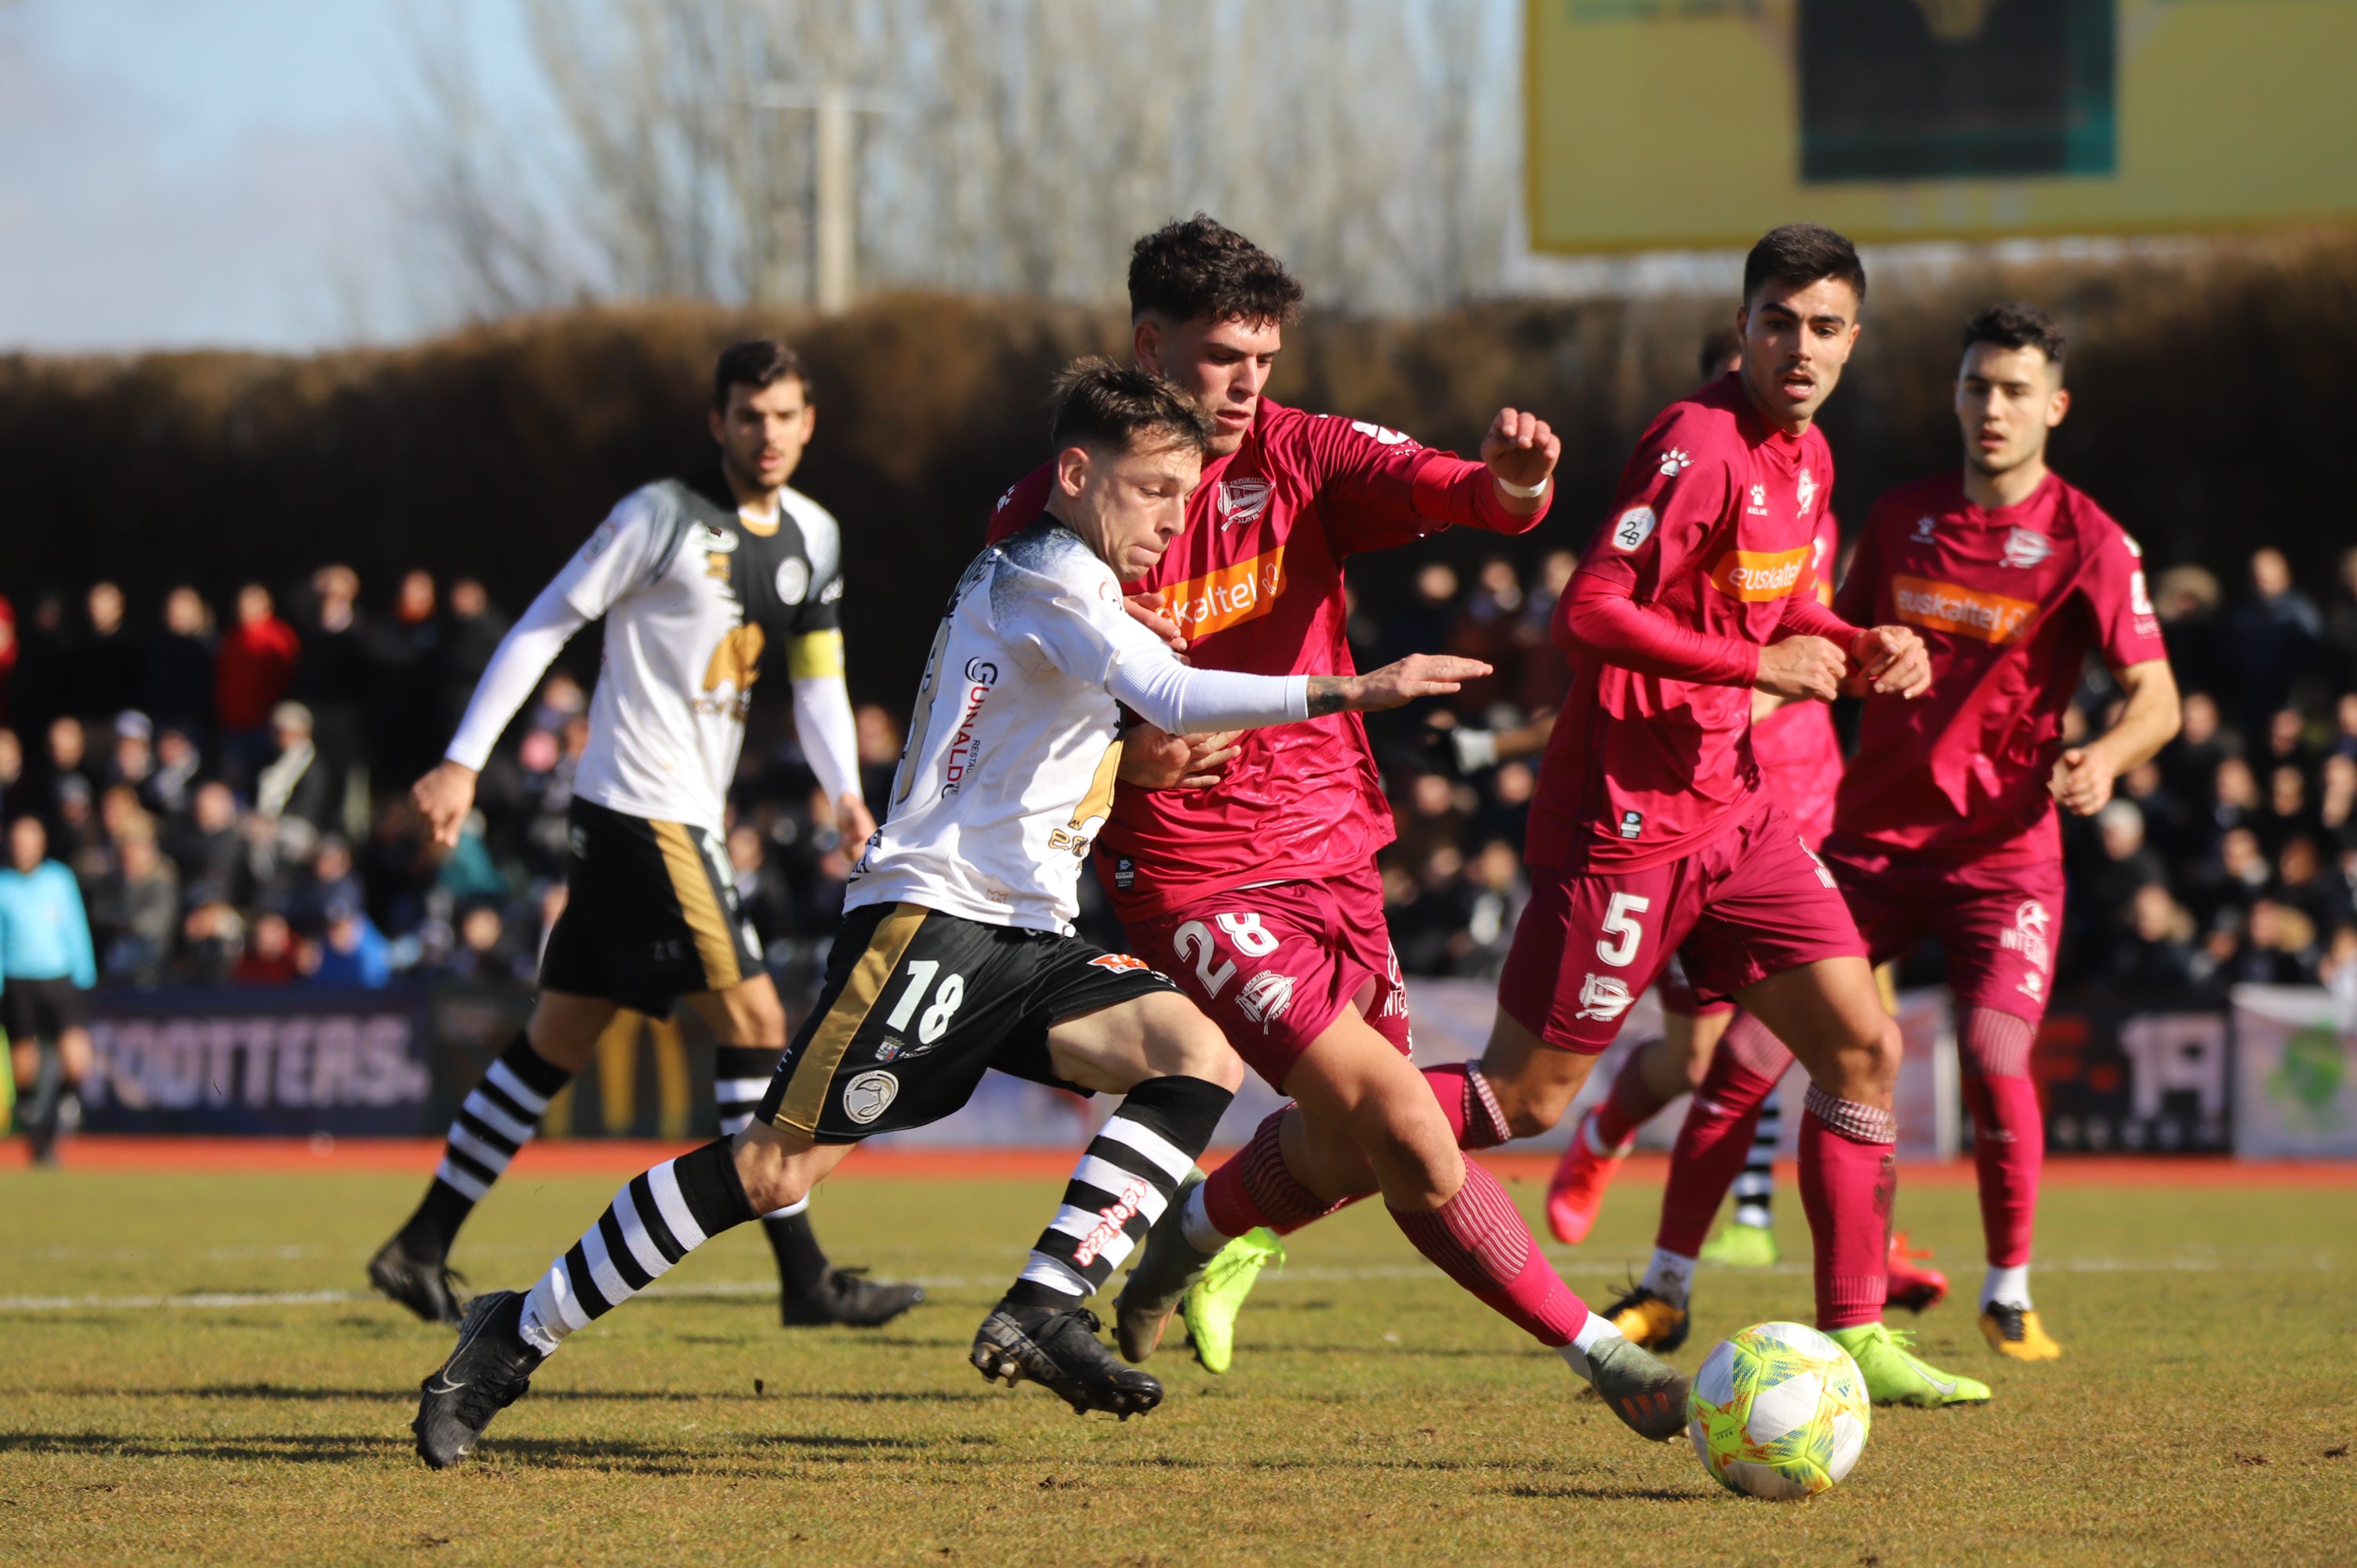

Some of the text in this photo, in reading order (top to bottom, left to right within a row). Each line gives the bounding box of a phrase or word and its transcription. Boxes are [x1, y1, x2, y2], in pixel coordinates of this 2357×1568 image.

[1728, 557, 1803, 590] euskaltel
[1898, 590, 2004, 631] euskaltel
[1173, 912, 1280, 1000] 28
[1596, 892, 1650, 967] 5
[885, 960, 964, 1045] 18
